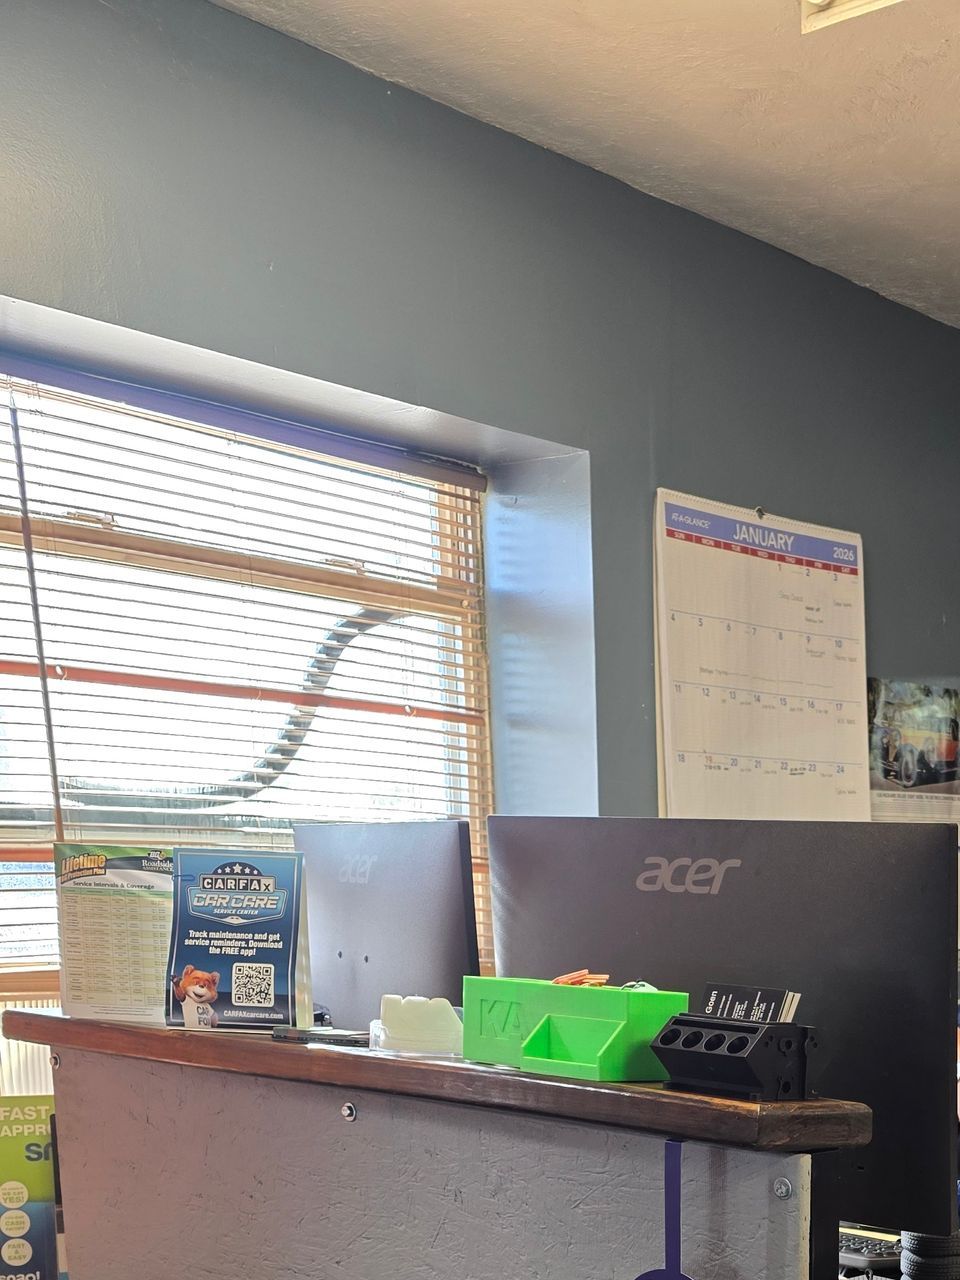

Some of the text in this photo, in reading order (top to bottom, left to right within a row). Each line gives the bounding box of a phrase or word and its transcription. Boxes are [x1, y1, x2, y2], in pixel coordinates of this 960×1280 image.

[734, 524, 795, 551] JANUARY
[833, 547, 854, 561] 2026
[62, 854, 106, 873] Lifetime
[635, 856, 741, 895] acer
[204, 879, 270, 892] CARFAX
[193, 894, 279, 908] CAR CARE
[189, 930, 280, 941] Track maintenance and get
[705, 991, 718, 1013] Goen
[224, 1010, 283, 1019] CARFAXcarcare.com
[1, 1106, 49, 1119] FAST
[0, 1124, 51, 1137] APPR
